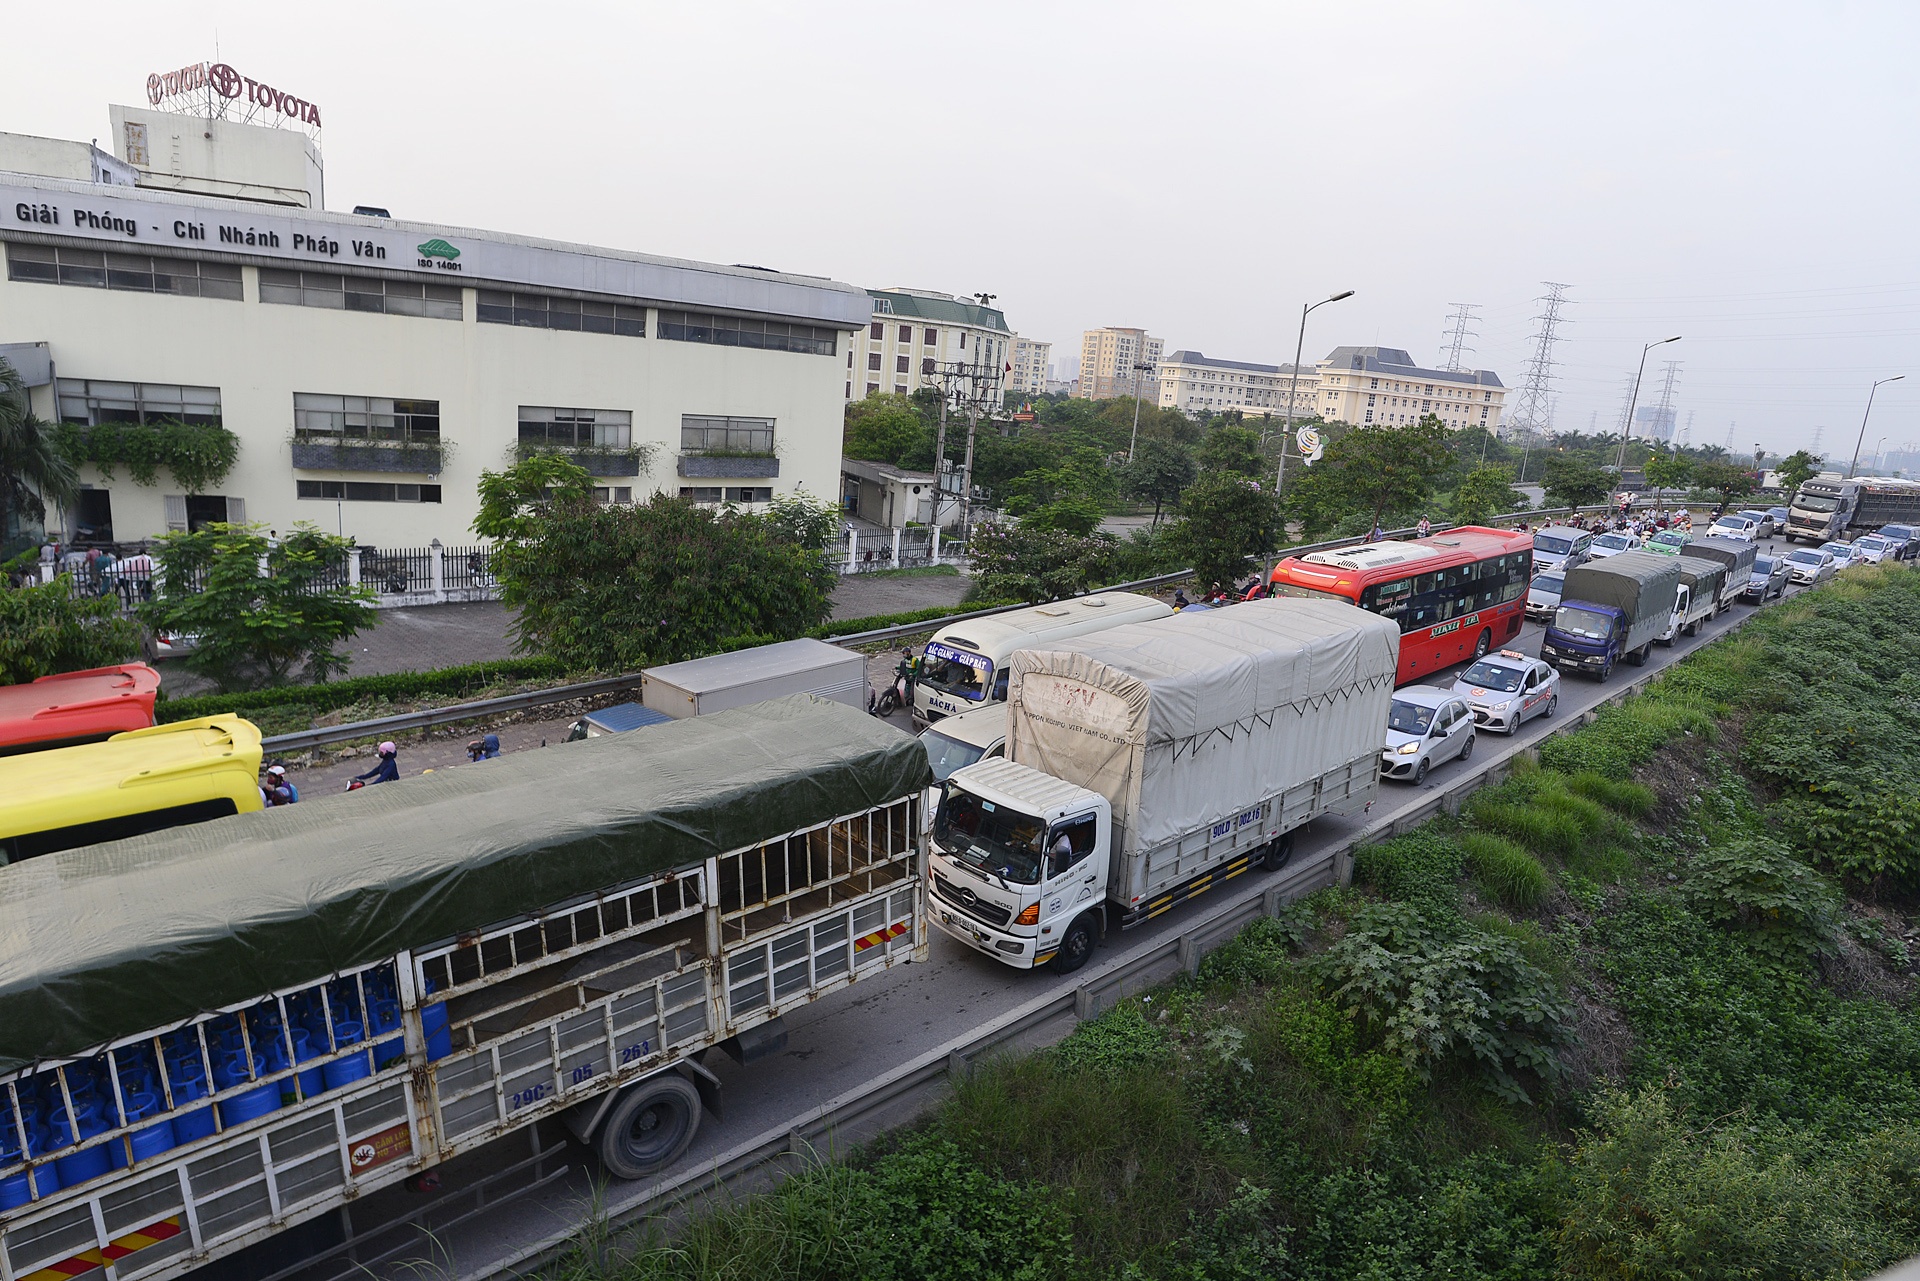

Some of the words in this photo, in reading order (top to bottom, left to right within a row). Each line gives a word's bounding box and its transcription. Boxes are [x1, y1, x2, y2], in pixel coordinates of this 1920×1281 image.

[161, 63, 207, 98] TOYOTA
[244, 77, 321, 128] TOYOTA
[16, 203, 59, 225] Giải
[73, 210, 136, 237] Phóng
[173, 220, 205, 241] Chi
[219, 225, 280, 248] Nhánh
[293, 233, 339, 258] Pháp
[352, 239, 386, 259] Vân
[417, 258, 433, 268] ISO
[436, 261, 462, 271] 14001
[1213, 820, 1231, 838] 90LD
[1055, 871, 1075, 887] HINO
[994, 899, 1013, 910] 500
[572, 1063, 593, 1084] 05
[622, 1041, 649, 1064] 263
